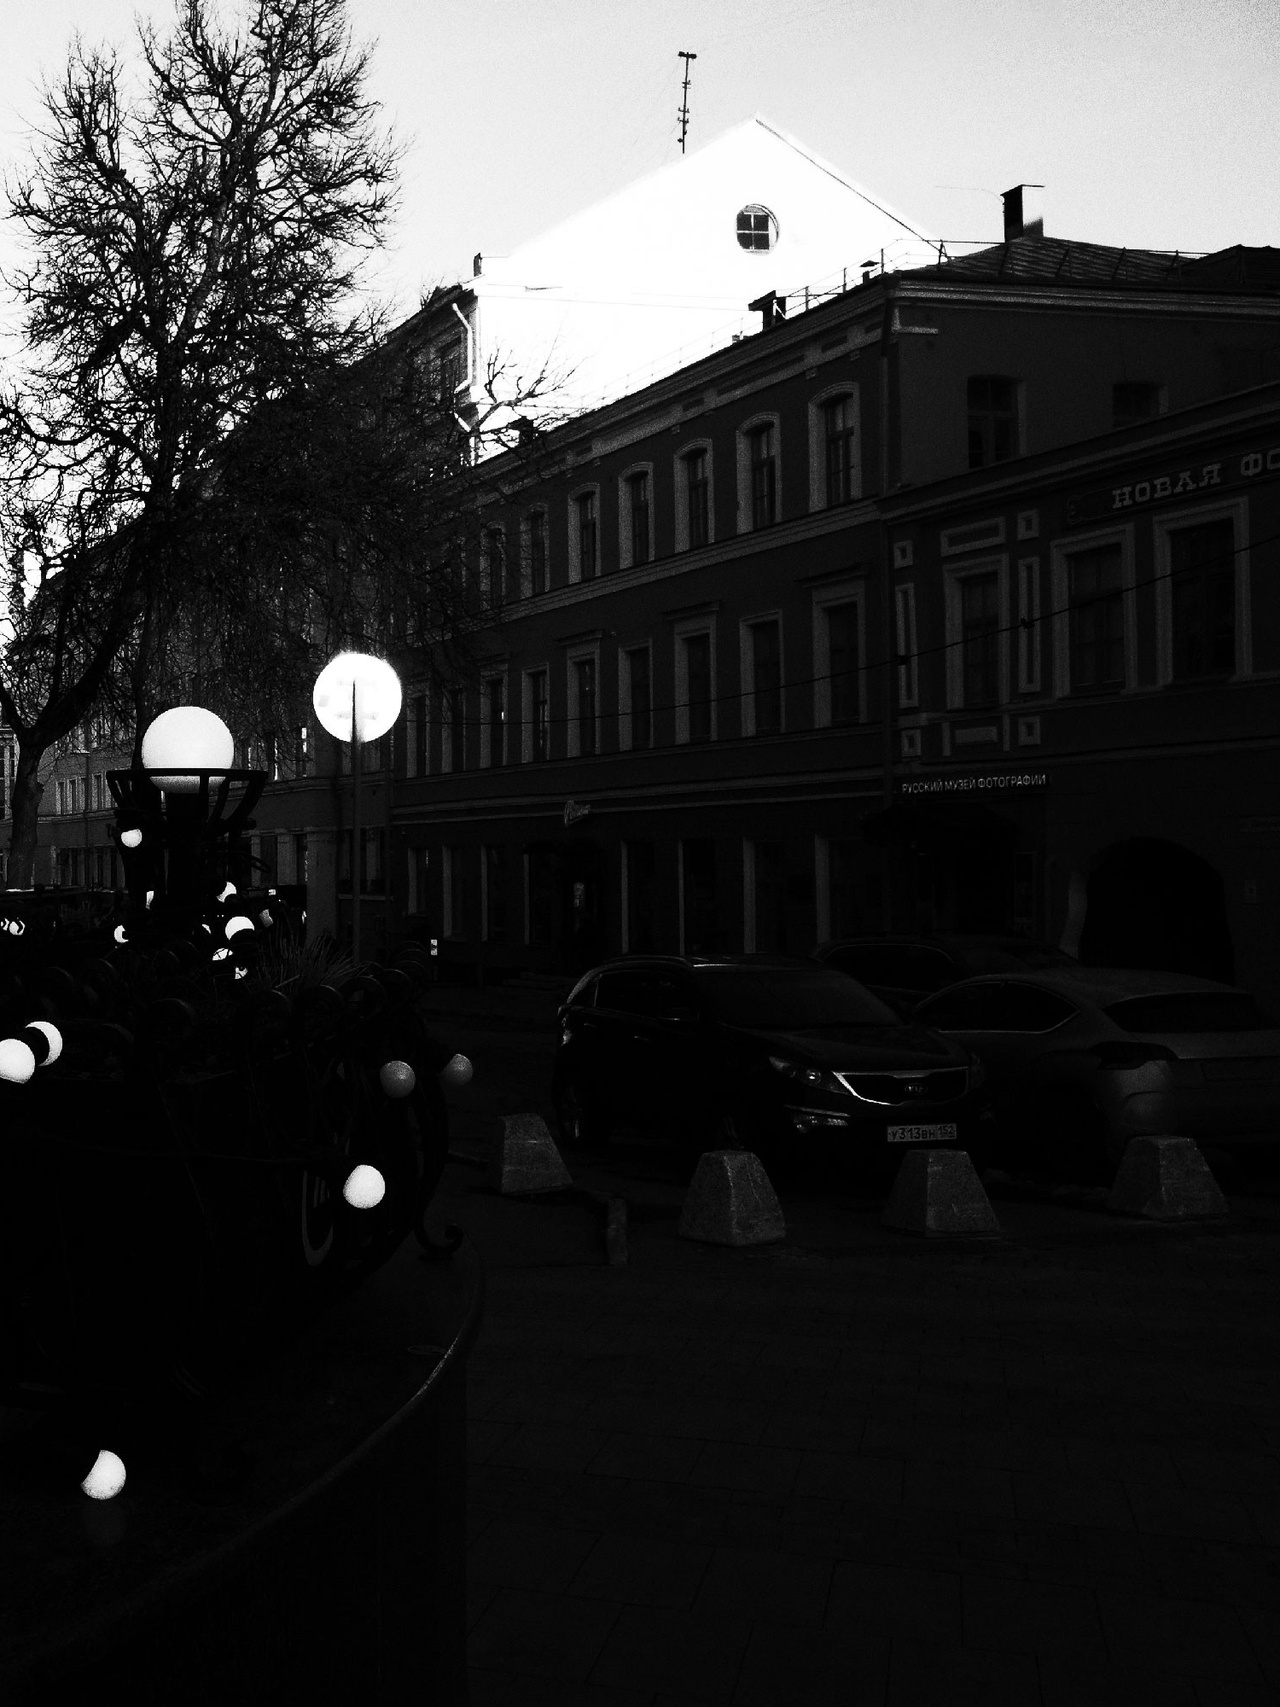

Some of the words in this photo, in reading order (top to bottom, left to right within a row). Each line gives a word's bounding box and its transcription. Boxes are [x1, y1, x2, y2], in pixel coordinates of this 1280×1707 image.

[1112, 463, 1222, 509] НОВАЯ
[901, 779, 944, 794] РУССКИЙ
[944, 777, 976, 791] МУЗЕЙ
[977, 774, 1046, 788] ФОТОГРАФИИ
